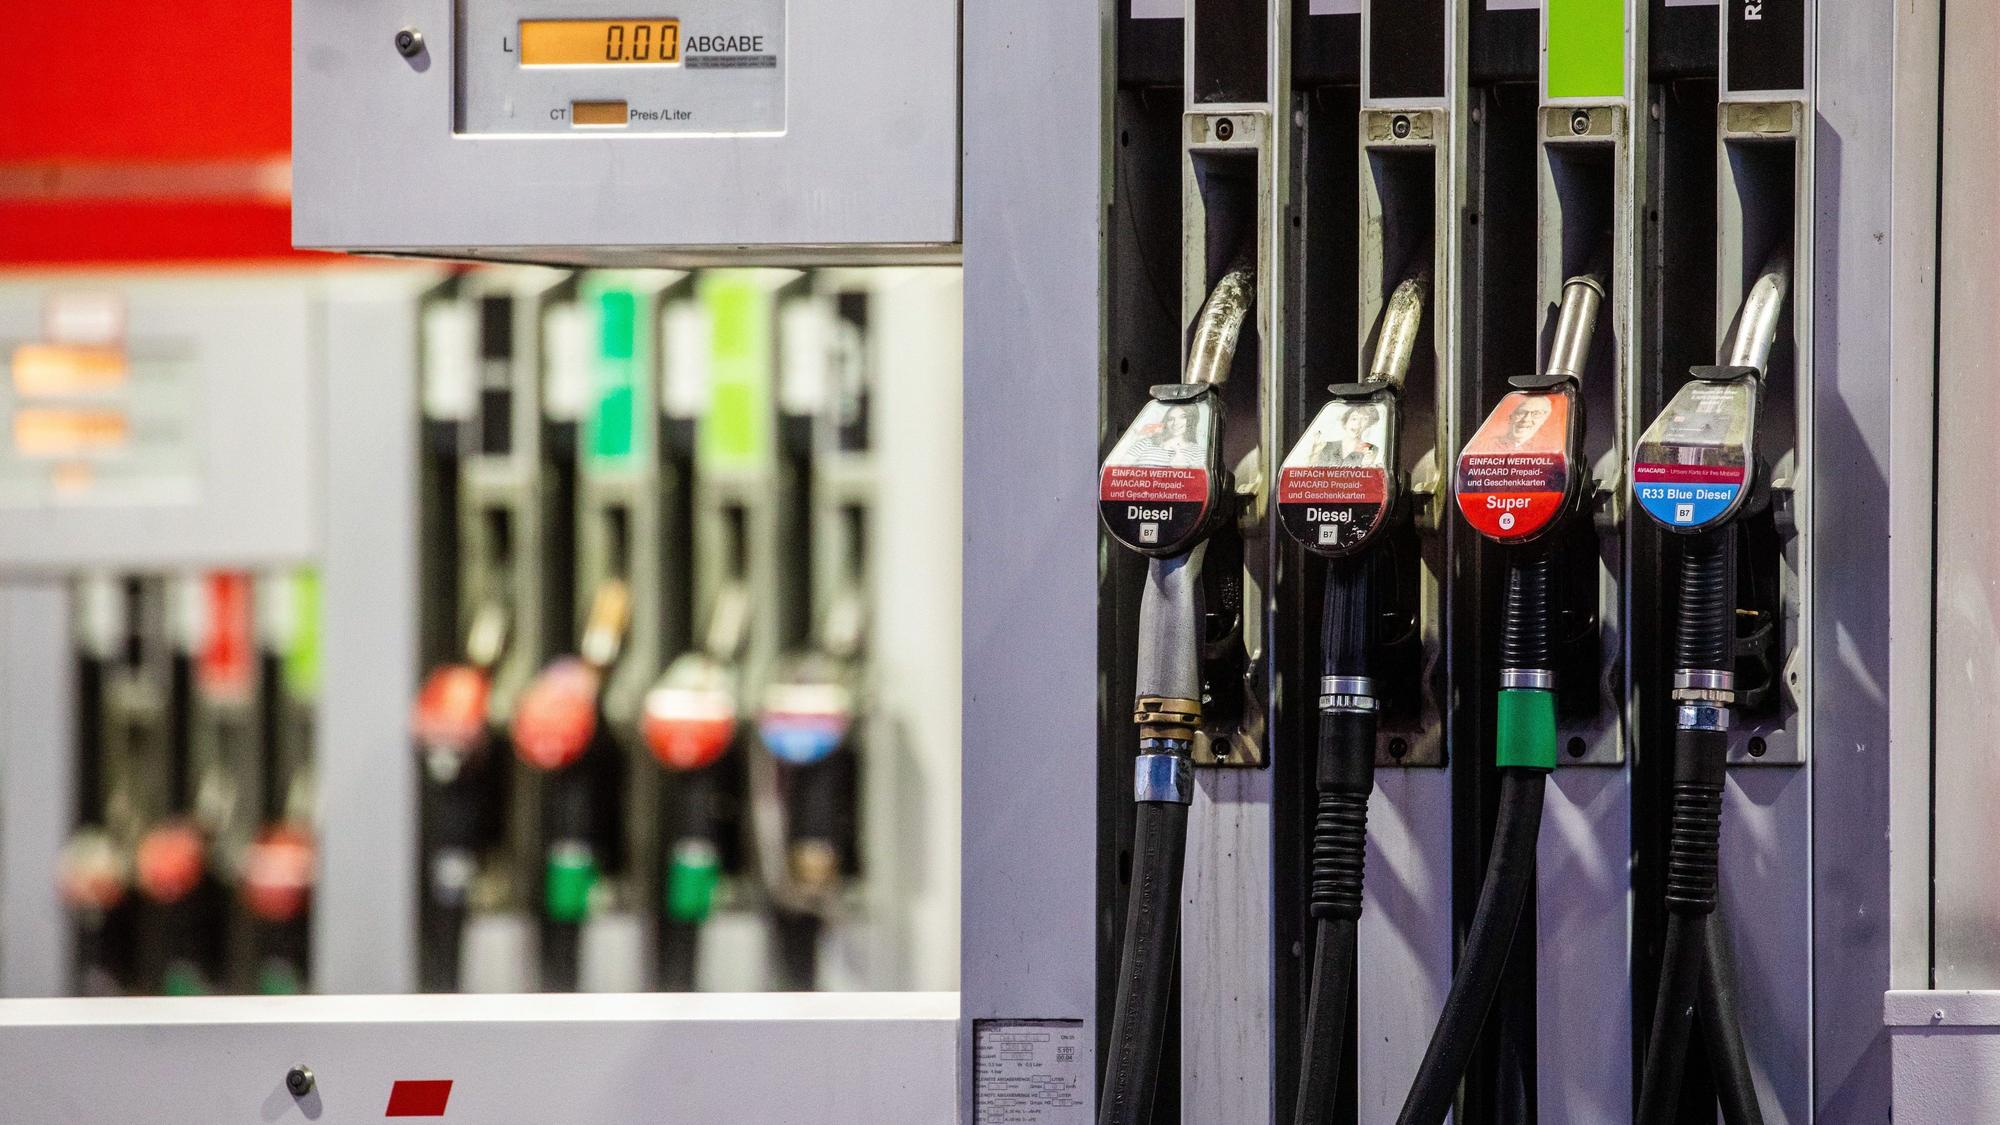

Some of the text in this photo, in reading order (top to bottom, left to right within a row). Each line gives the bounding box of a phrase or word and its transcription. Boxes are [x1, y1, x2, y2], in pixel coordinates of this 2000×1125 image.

[1744, 0, 1762, 20] R
[503, 36, 513, 53] L
[605, 25, 678, 61] 0.00
[685, 36, 764, 52] ABGABE
[550, 109, 566, 121] CT
[1469, 457, 1554, 466] EINFACH WERTVOLL.
[1111, 468, 1196, 479] EINFACH WERTVOLL.
[1289, 470, 1325, 478] EINFACH
[1467, 467, 1543, 478] AVIACARD Prepaid-
[1110, 479, 1185, 490] AVIACARD Prepaid-
[1288, 480, 1363, 491] AVIACARD Prepaid-
[1467, 478, 1546, 487] und Geschenkkarten
[1110, 490, 1187, 500] und Geschenkkarten
[1288, 491, 1366, 499] und Geschenkkarten
[1642, 488, 1731, 500] R33 Blue Diesel
[1486, 496, 1532, 512] Super
[1127, 505, 1173, 521] Diesel
[1306, 507, 1352, 522] Diesel
[1679, 509, 1690, 517] B7
[1143, 529, 1154, 537] B7
[1323, 530, 1334, 538] B7
